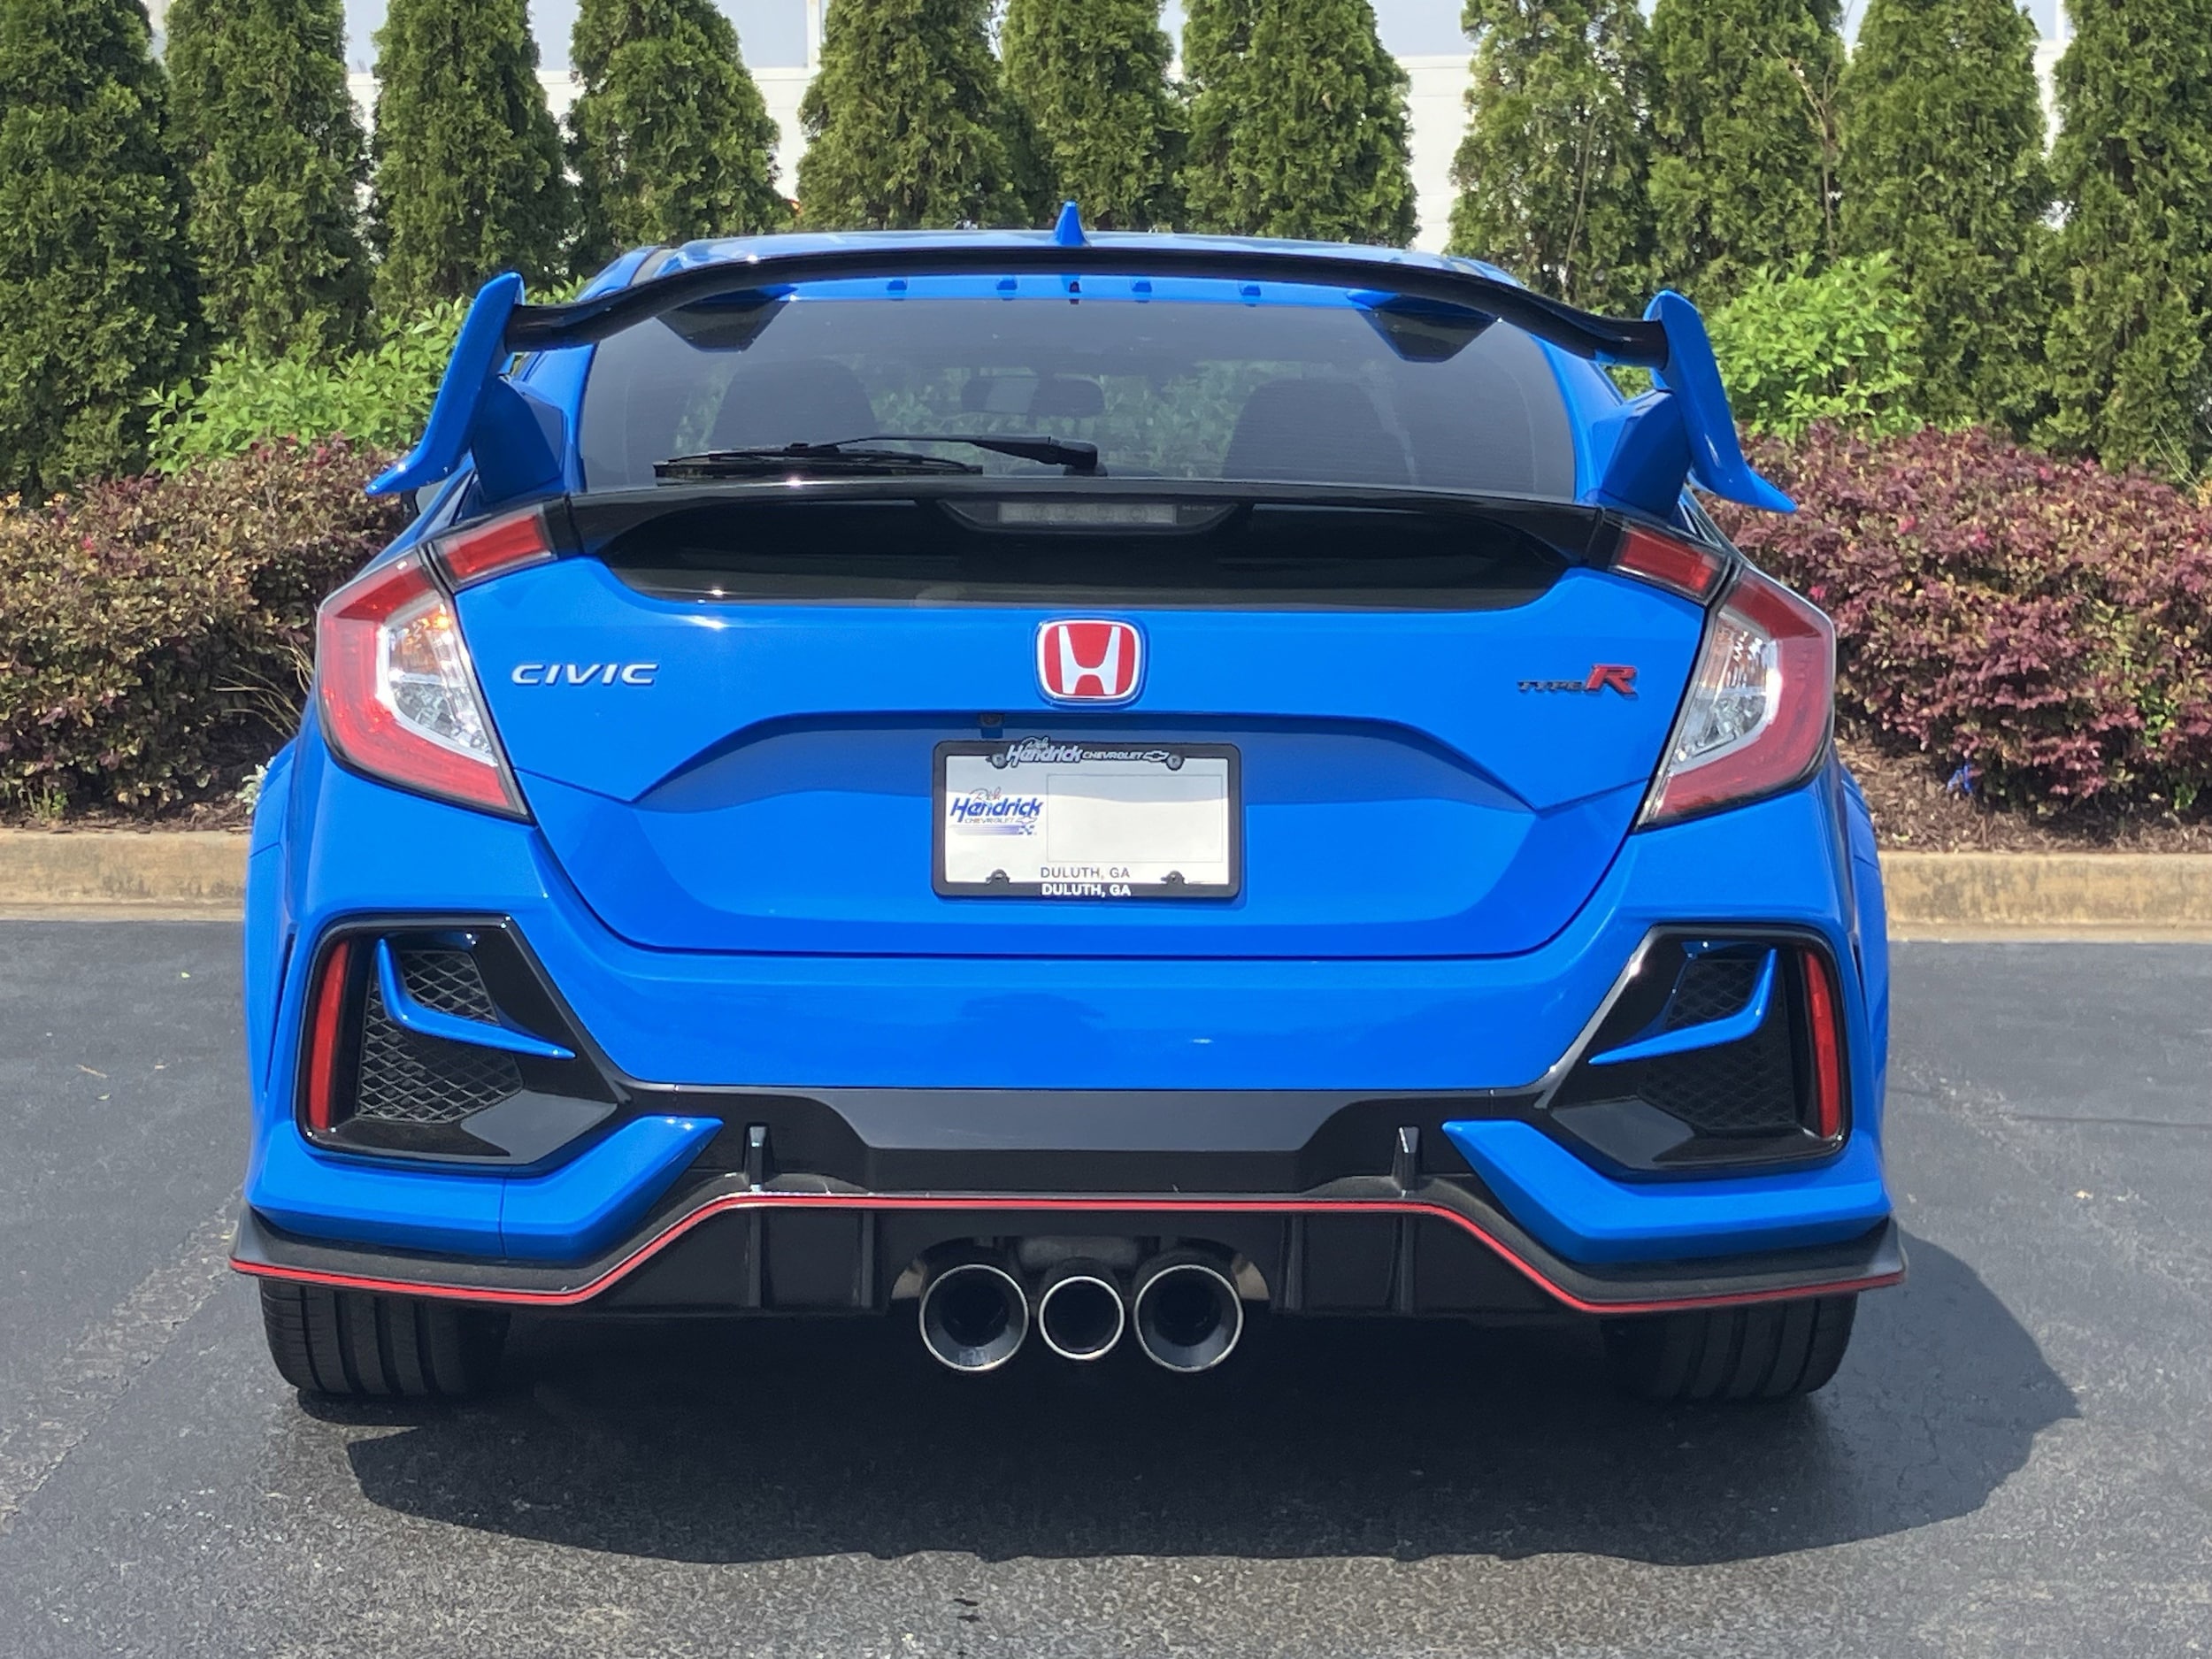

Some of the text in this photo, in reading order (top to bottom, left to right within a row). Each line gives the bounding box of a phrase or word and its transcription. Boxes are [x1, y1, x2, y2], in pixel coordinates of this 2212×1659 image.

[511, 664, 659, 686] CIVIC
[1517, 664, 1637, 695] TYPE R
[1005, 744, 1144, 767] Hendrick CHEVROLET
[949, 797, 1044, 823] Hendrick
[1041, 866, 1131, 880] DULUTH, GA
[1041, 883, 1132, 898] DULUTH, GA
